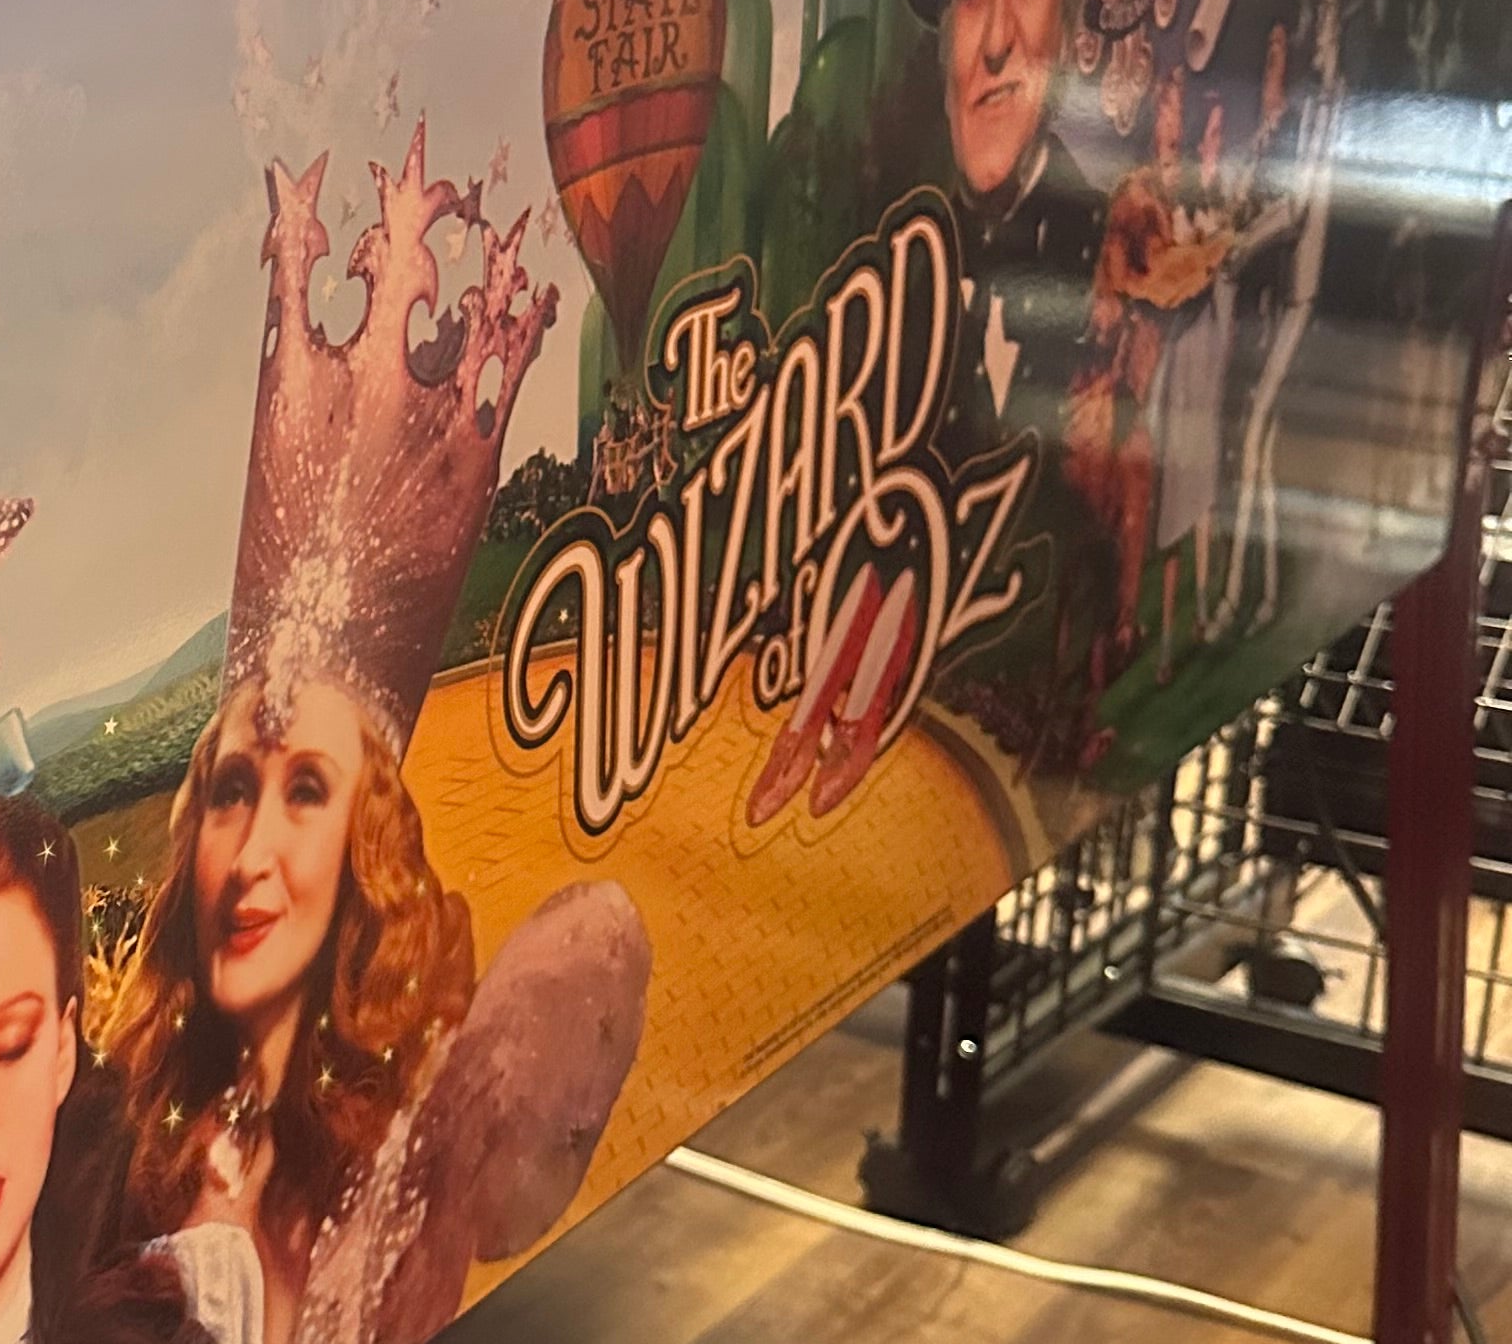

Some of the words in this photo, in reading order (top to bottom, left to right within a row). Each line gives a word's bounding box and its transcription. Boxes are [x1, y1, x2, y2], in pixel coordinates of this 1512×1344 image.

[586, 21, 688, 96] FAIR
[662, 284, 758, 434] The
[506, 216, 949, 834] WIZARD
[756, 558, 820, 710] of
